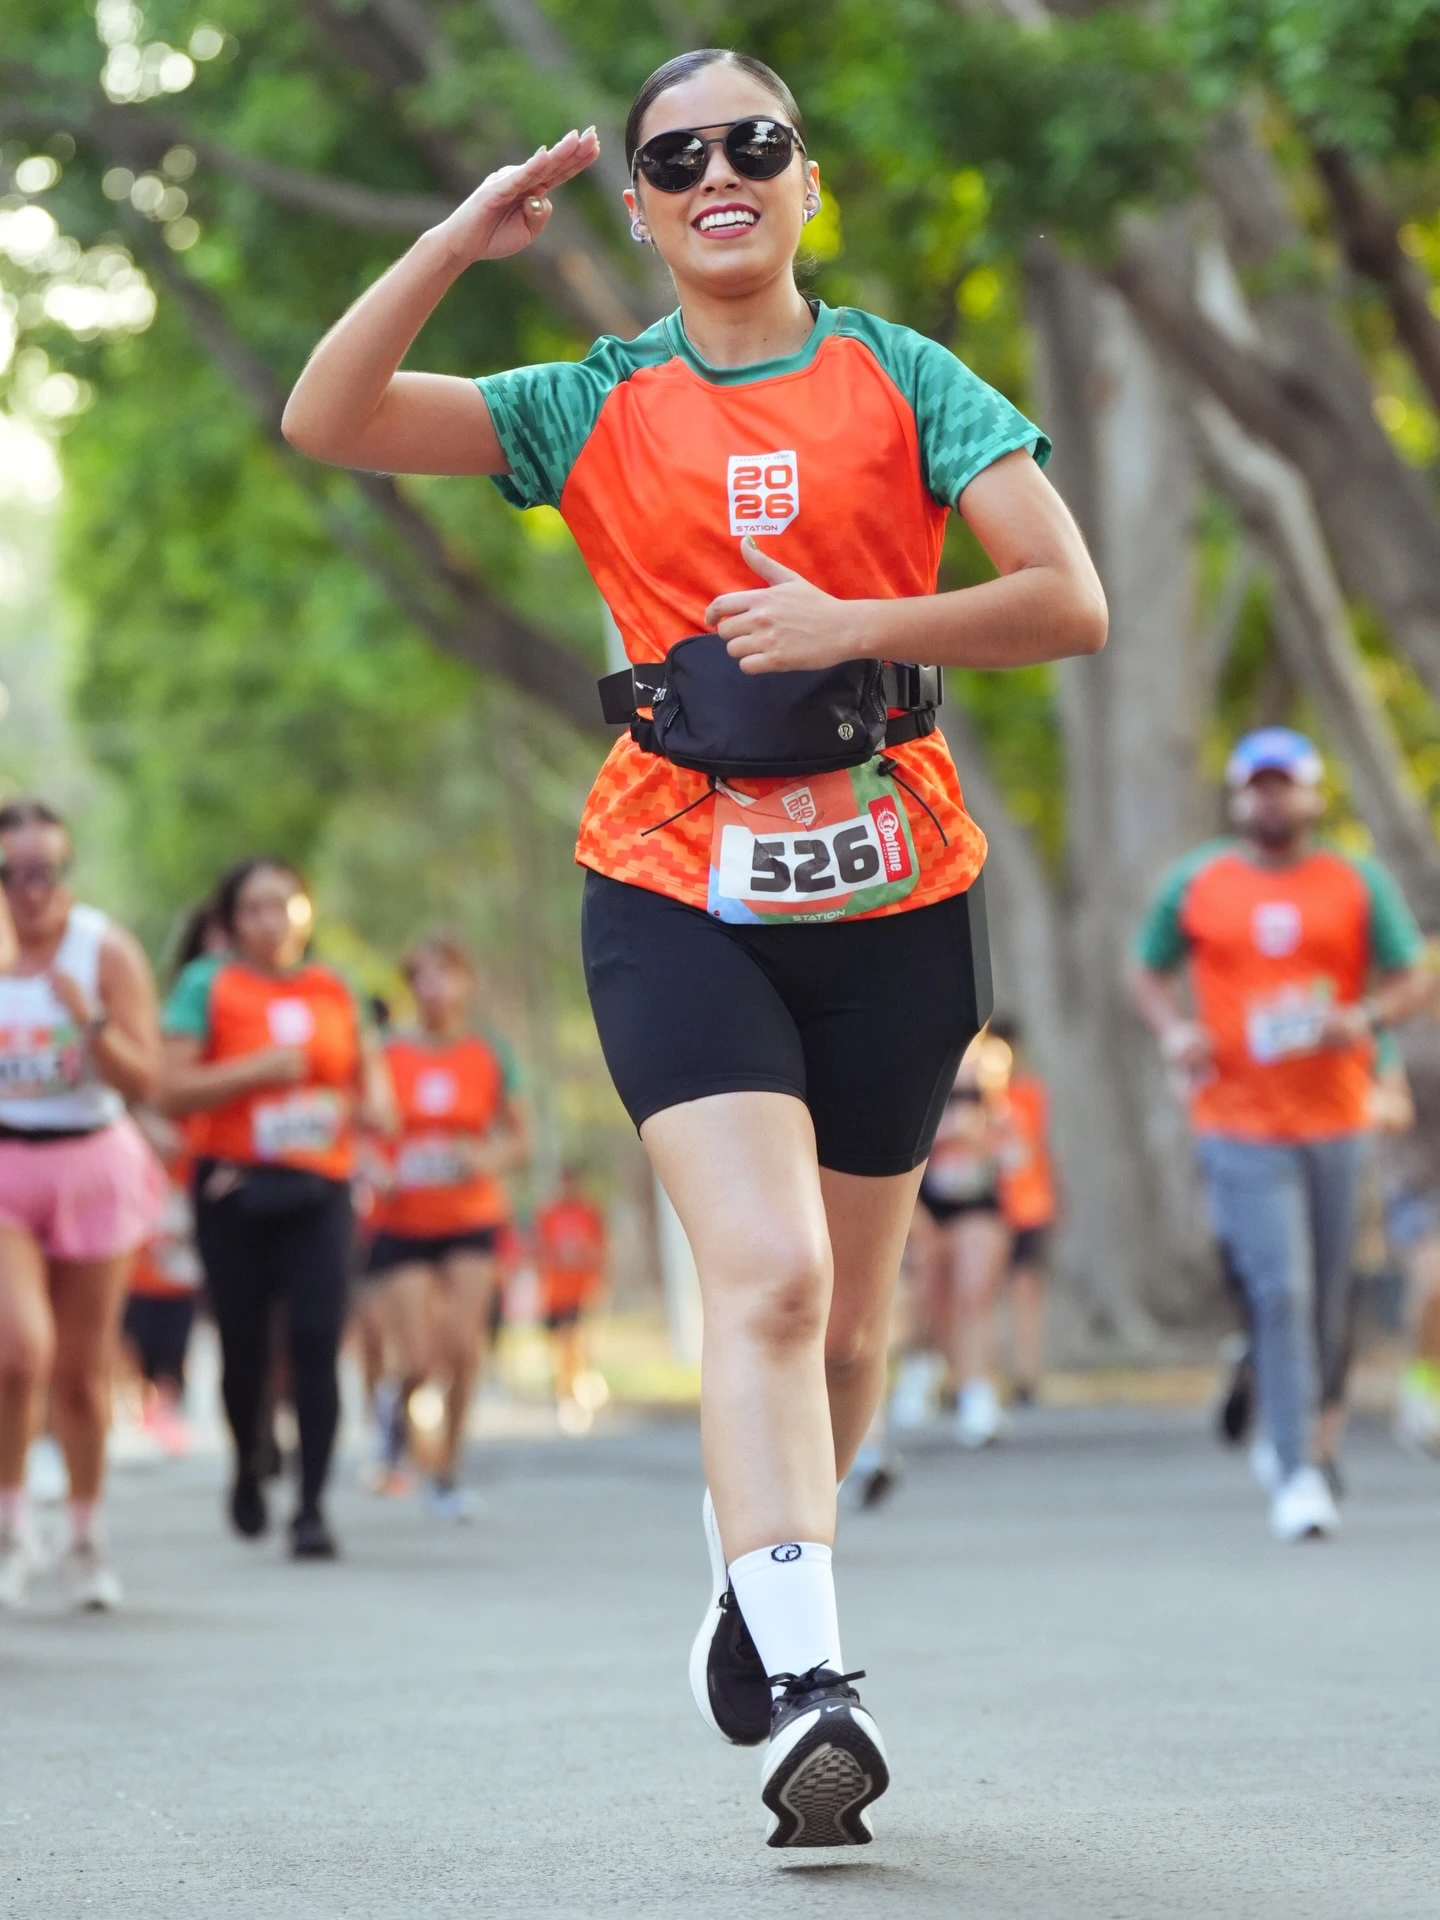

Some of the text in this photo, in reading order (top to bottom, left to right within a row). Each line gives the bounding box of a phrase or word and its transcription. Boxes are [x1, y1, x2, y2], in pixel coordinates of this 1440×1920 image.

[733, 464, 793, 491] 20
[735, 493, 795, 520] 26
[750, 825, 880, 893] 526
[792, 909, 846, 922] STATION
